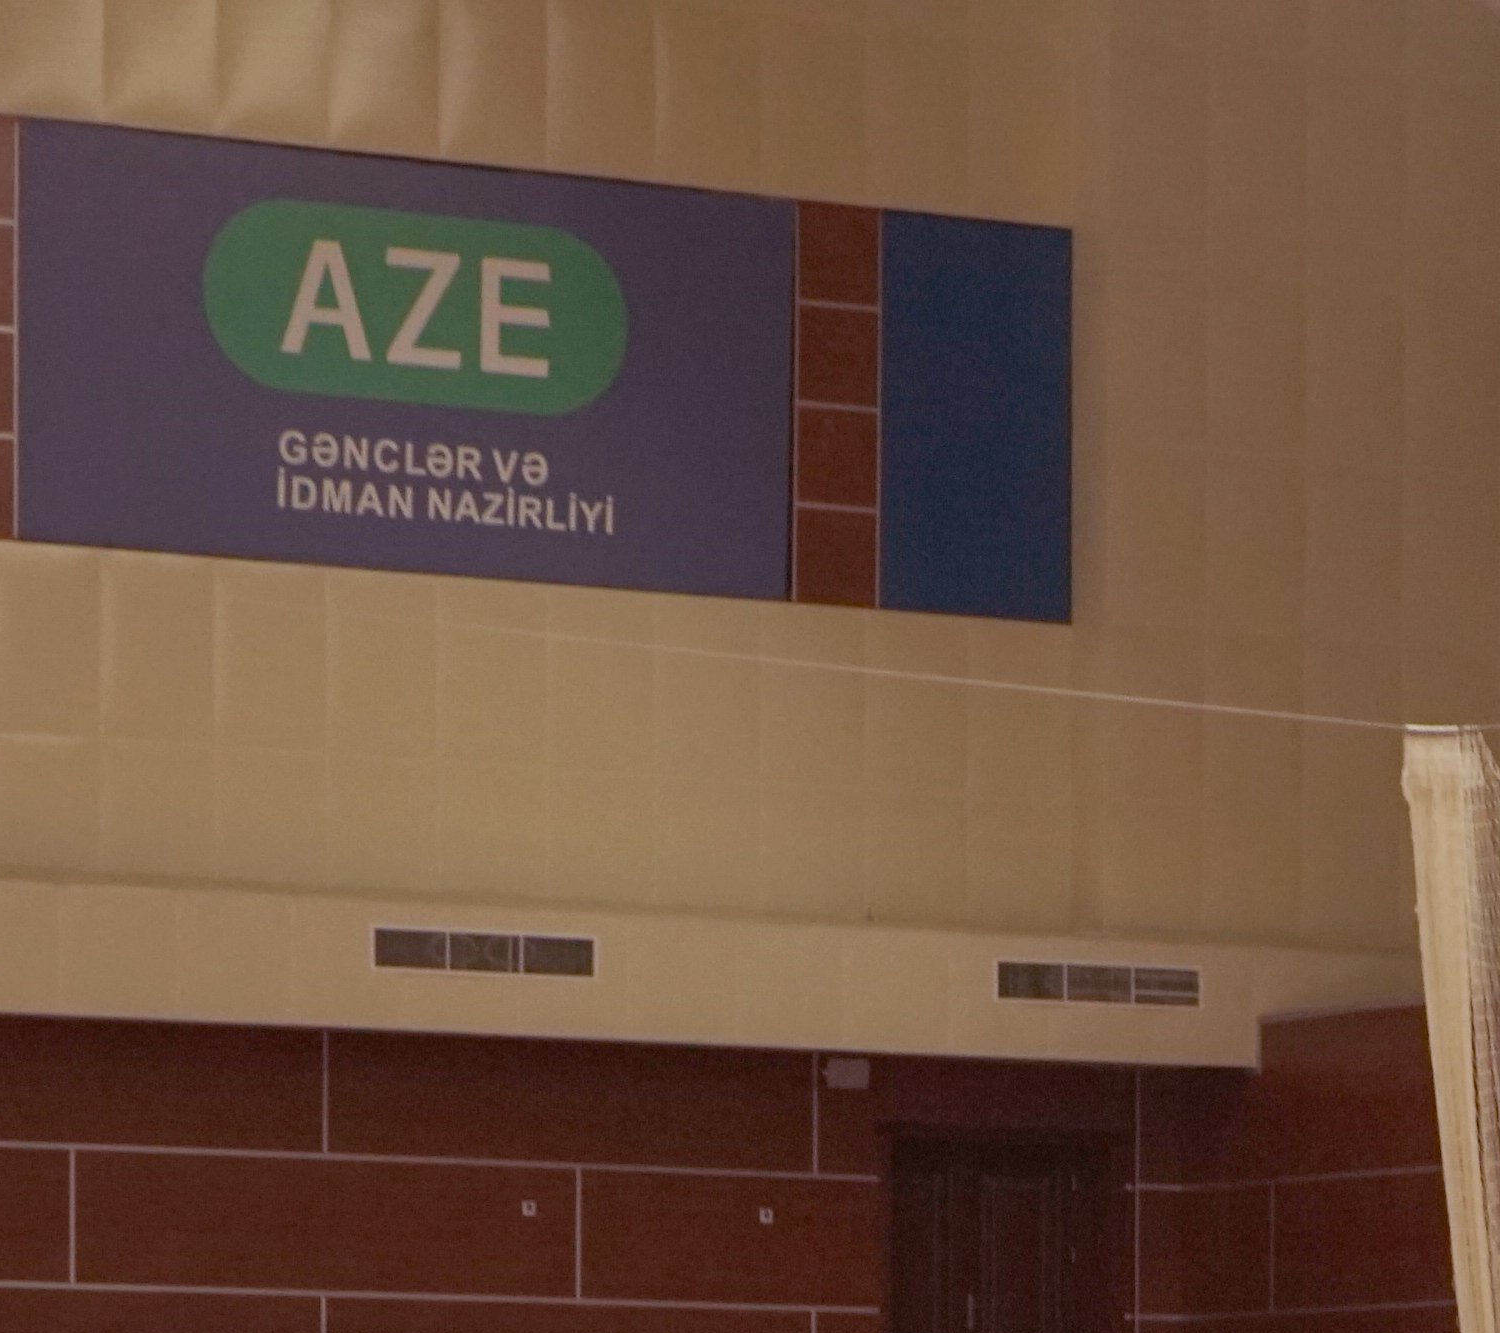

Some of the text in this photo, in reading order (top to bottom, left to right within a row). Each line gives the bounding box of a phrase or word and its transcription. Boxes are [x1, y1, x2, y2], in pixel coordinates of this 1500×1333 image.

[281, 241, 551, 378] AZE
[278, 430, 550, 487] GƏNCLƏR VƏ
[276, 466, 614, 535] İDMAN NAZİRLİYİ
